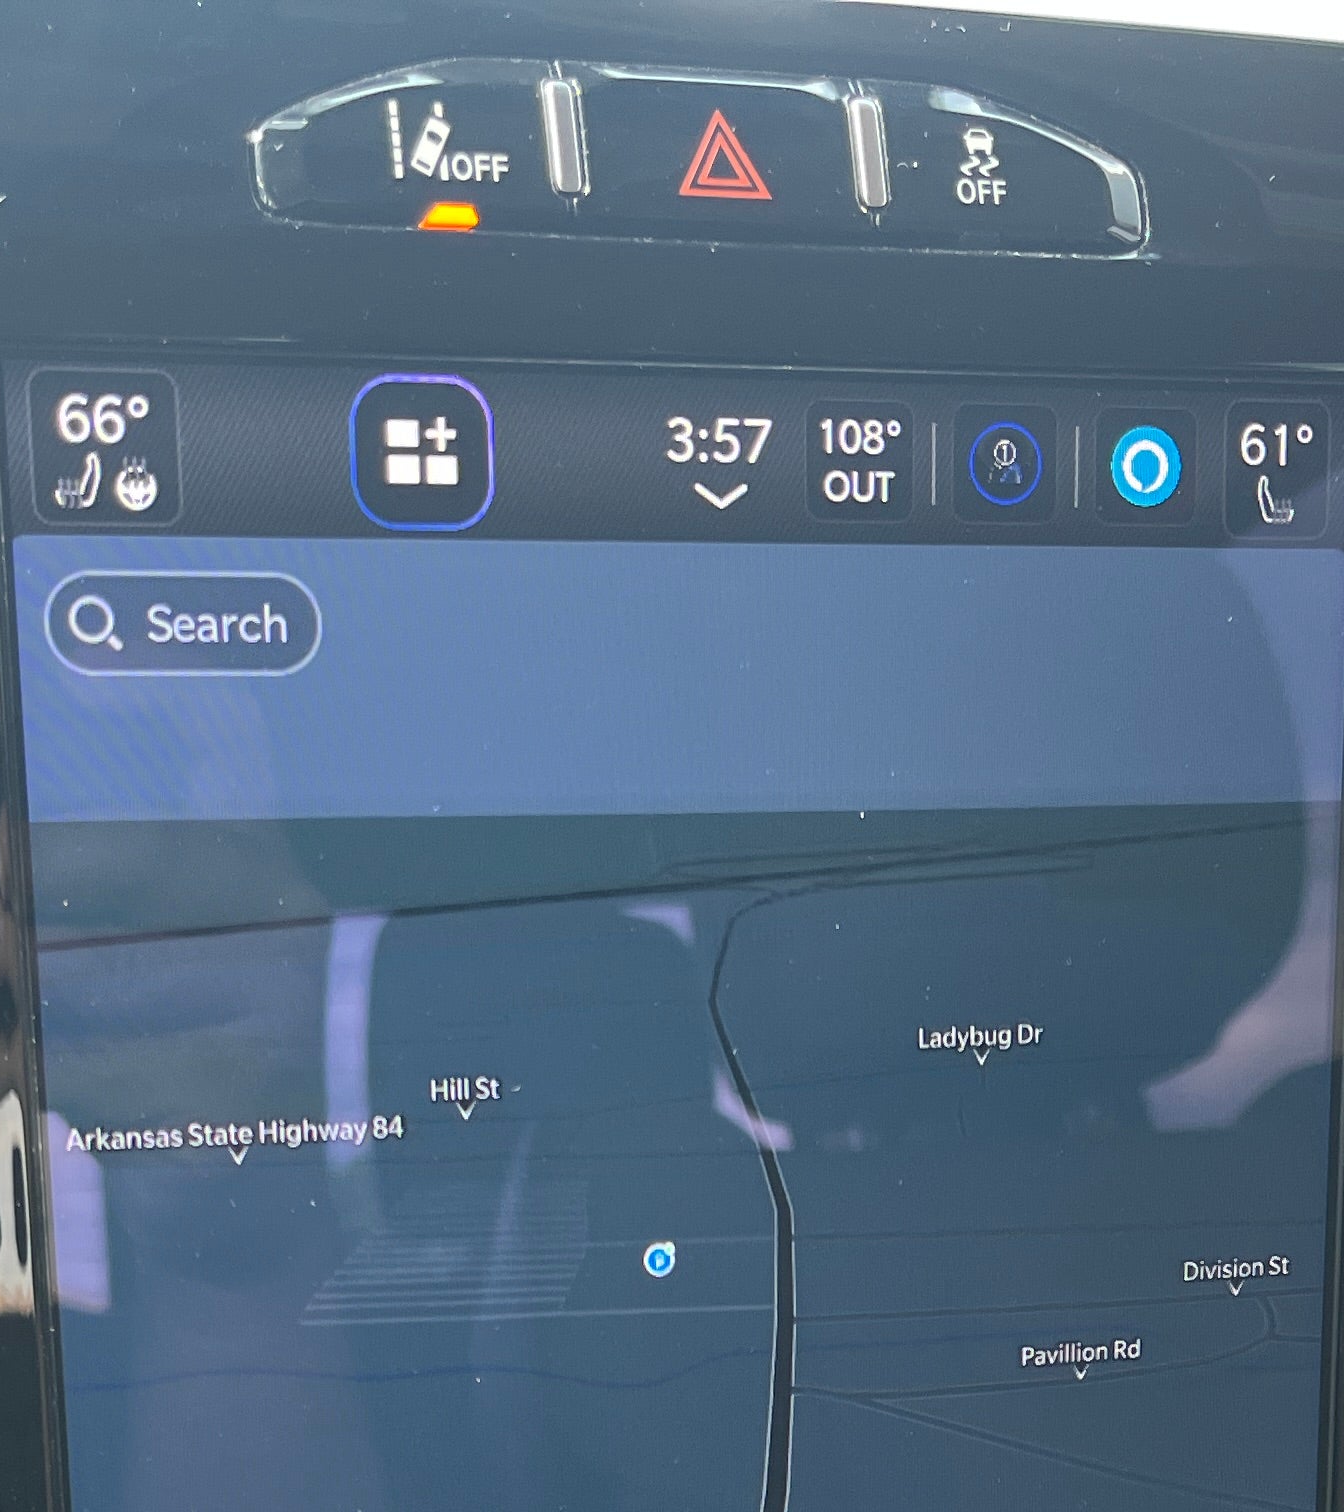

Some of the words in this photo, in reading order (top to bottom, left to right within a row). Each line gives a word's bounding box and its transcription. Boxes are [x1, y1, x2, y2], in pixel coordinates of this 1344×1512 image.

[451, 153, 510, 182] OFF
[956, 177, 1007, 206] OFF
[56, 393, 150, 445] 66°
[818, 417, 902, 455] 108°
[666, 416, 773, 466] 3:57
[1238, 422, 1314, 469] 61°
[823, 469, 896, 504] OUT
[146, 604, 288, 645] Search
[918, 1024, 1013, 1052] Ladybug
[1017, 1023, 1044, 1045] Dr
[430, 1077, 471, 1101] Hill
[475, 1075, 501, 1100] St
[65, 1126, 184, 1152] Arkansas
[187, 1122, 254, 1148] State
[258, 1118, 368, 1148] Highway
[372, 1115, 405, 1140] 84
[1182, 1258, 1265, 1283] Division
[1268, 1255, 1291, 1277] St
[1020, 1341, 1109, 1368] Pavillion
[1113, 1338, 1142, 1361] Rd
